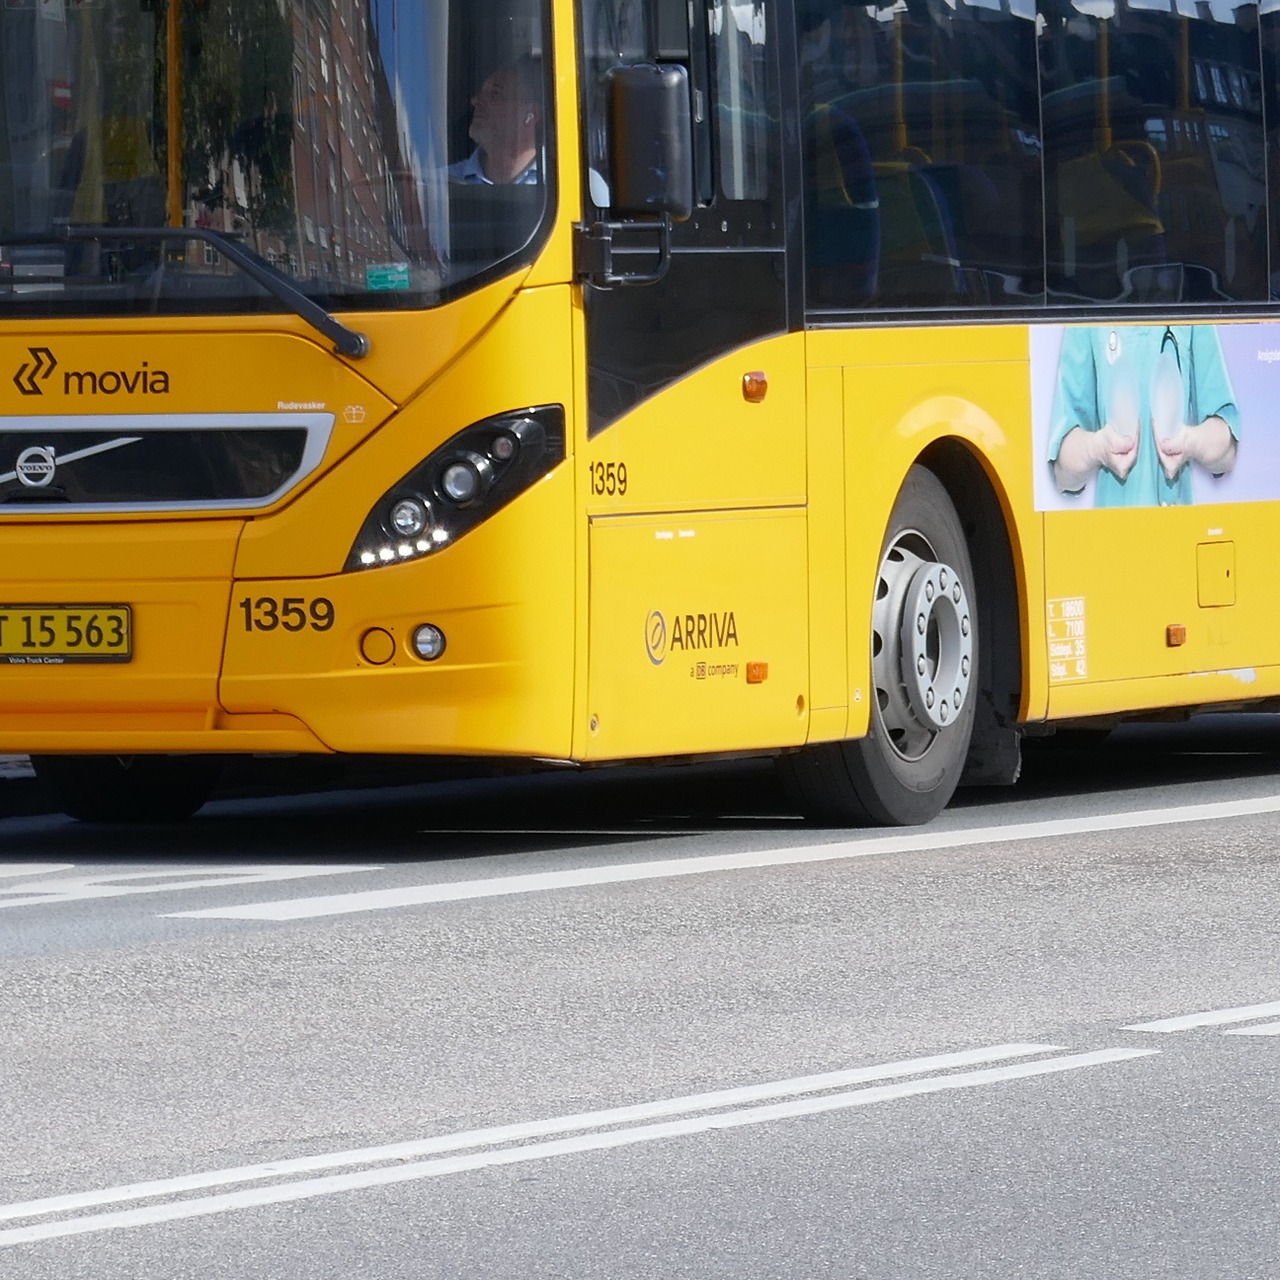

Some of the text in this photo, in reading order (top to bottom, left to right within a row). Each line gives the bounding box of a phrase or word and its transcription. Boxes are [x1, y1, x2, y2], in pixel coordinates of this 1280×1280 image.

[63, 361, 170, 395] movia
[277, 401, 326, 410] Rudevasker
[18, 464, 53, 472] VOLVO
[589, 461, 628, 496] 1359
[239, 597, 335, 633] 1359
[1061, 599, 1084, 618] 18600
[21, 615, 56, 648] 15
[66, 615, 125, 648] 563
[670, 612, 738, 651] ARRIVA
[1065, 619, 1084, 637] 7100
[1075, 639, 1084, 657] 35
[690, 667, 695, 677] a
[708, 663, 738, 678] company
